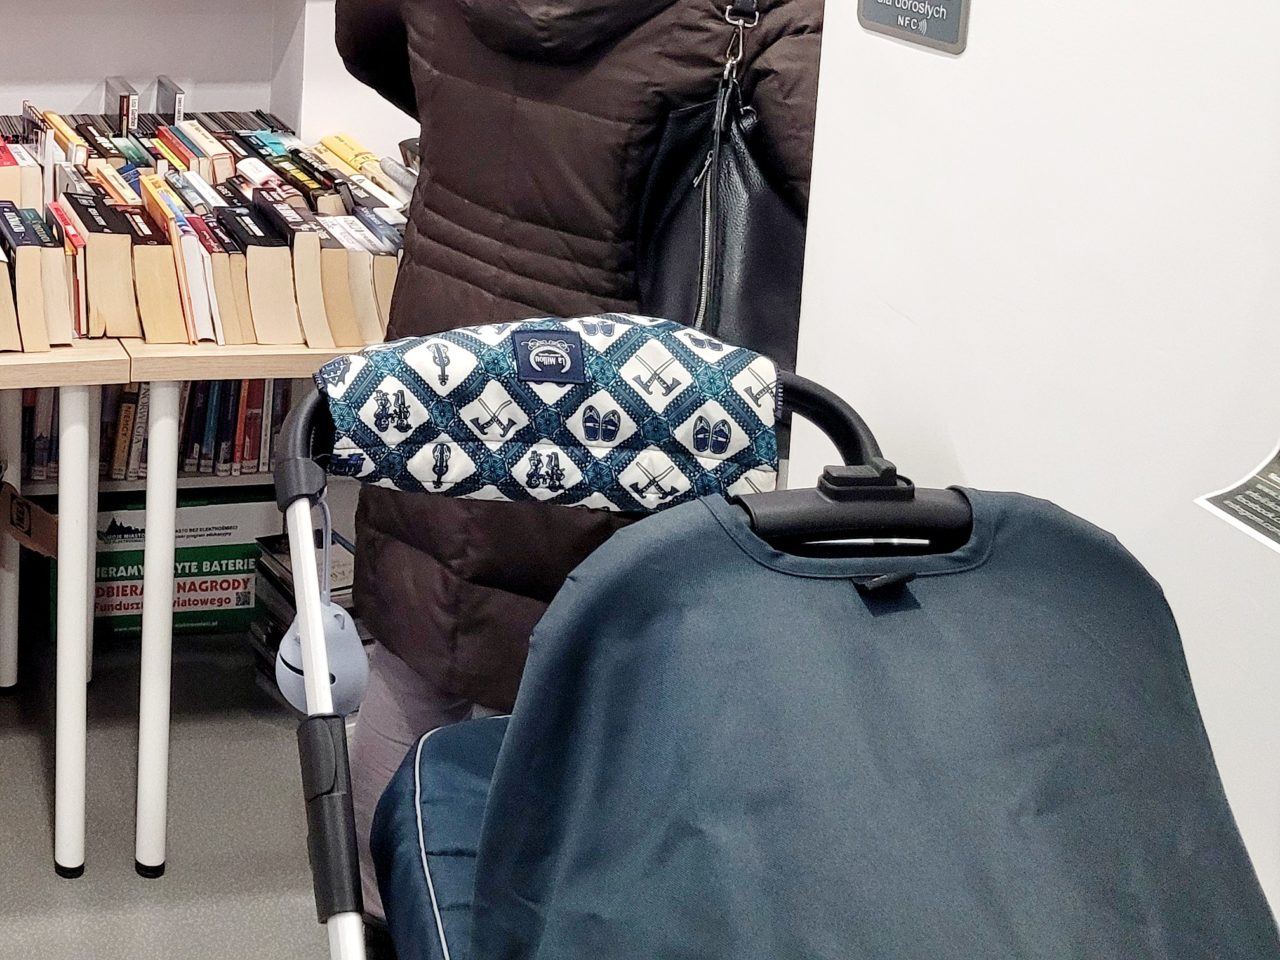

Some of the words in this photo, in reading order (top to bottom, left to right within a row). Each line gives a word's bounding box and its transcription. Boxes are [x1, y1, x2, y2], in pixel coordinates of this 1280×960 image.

[897, 14, 918, 30] NFC
[535, 355, 556, 366] Millou
[96, 564, 144, 578] IERAMY
[174, 562, 198, 574] YTE
[202, 558, 256, 573] BATERIE
[176, 578, 251, 593] NAGRODY
[94, 600, 143, 613] Fundusz
